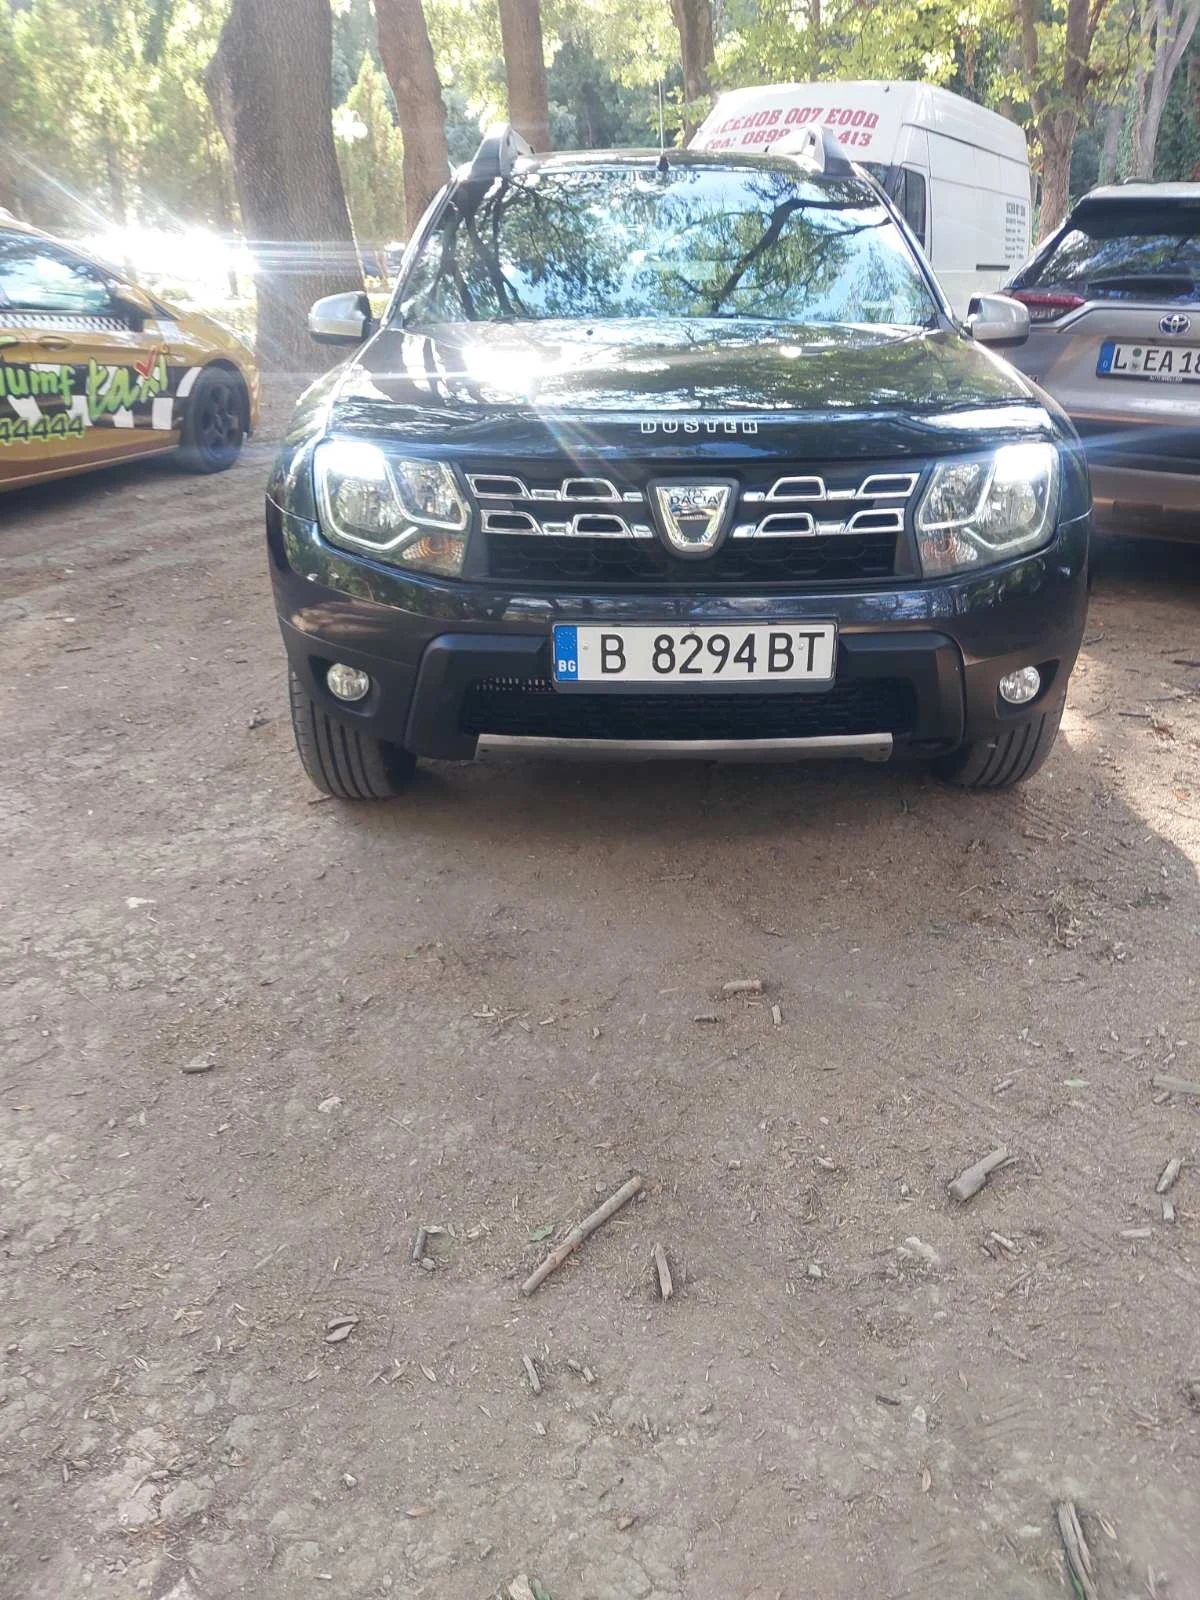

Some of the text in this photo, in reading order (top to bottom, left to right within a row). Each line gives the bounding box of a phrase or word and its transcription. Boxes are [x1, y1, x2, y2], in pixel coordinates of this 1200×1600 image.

[784, 107, 824, 125] 007
[838, 130, 873, 148] 413
[1113, 347, 1128, 370] L
[1143, 349, 1173, 373] EA
[640, 420, 758, 434] DUSTER
[670, 495, 719, 505] DACIA
[558, 660, 577, 672] BG
[600, 633, 627, 674] B
